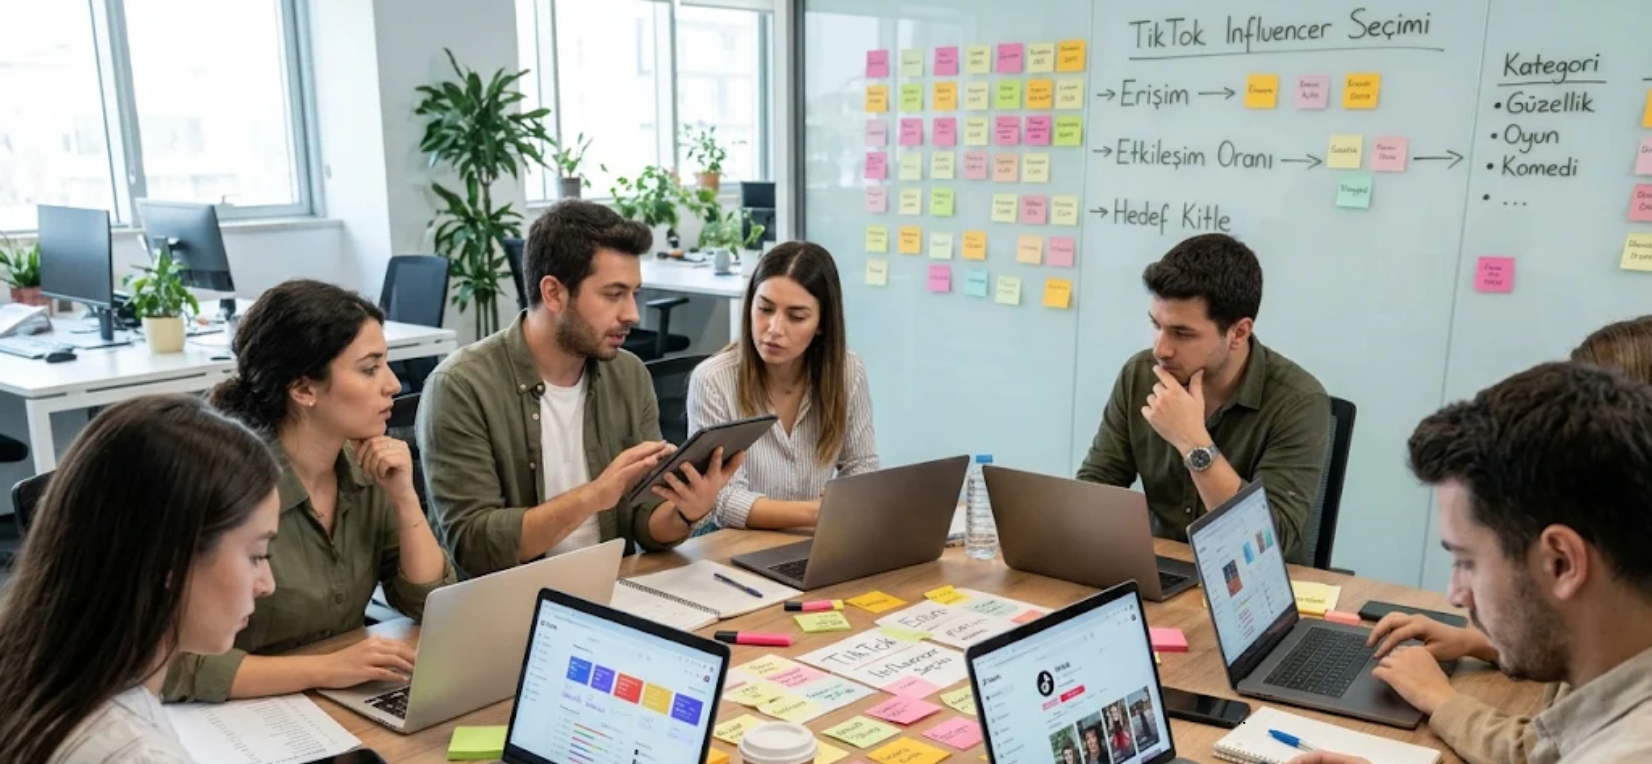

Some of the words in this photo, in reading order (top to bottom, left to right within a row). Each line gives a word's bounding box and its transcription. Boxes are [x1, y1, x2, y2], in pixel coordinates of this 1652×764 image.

[1128, 18, 1207, 48] TikTok
[1226, 16, 1332, 52] Influencer
[1348, 8, 1431, 40] Seçimi
[1503, 52, 1600, 84] Kategori
[1120, 79, 1189, 109] Erişim
[1505, 91, 1596, 114] Güzellik
[1504, 123, 1560, 153] Oyun
[1115, 138, 1206, 169] Etkileşim
[1217, 140, 1273, 170] Oranı
[1501, 155, 1579, 177] Komedi
[1113, 198, 1169, 234] Hedef
[1182, 204, 1231, 232] Kitle
